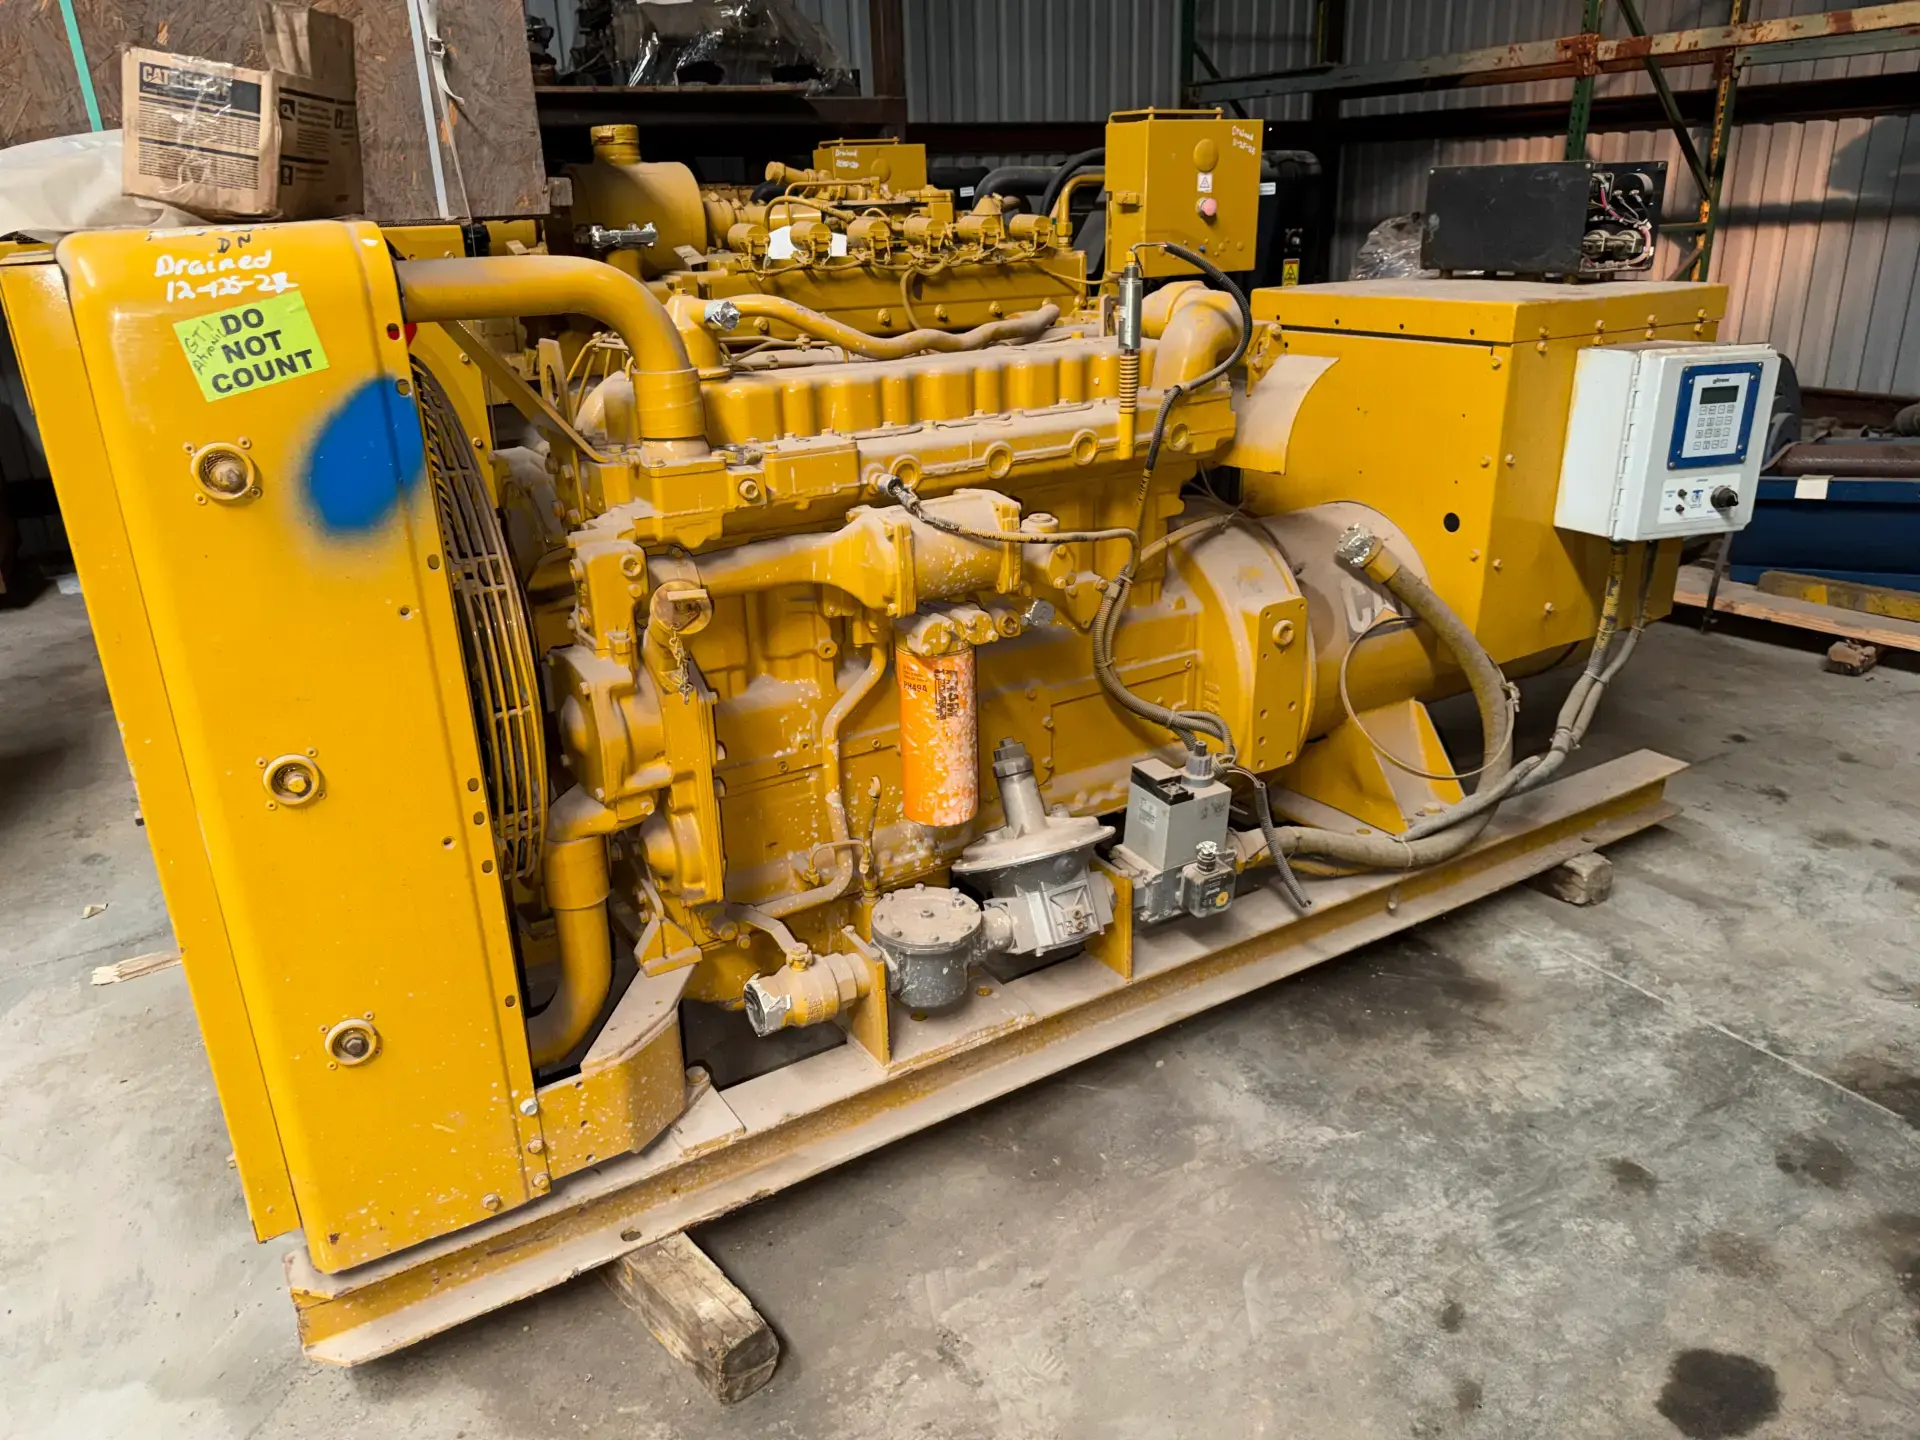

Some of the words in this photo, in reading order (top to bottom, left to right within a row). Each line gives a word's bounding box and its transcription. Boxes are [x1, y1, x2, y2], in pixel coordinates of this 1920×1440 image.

[142, 65, 169, 85] CAT
[154, 249, 272, 277] Drained
[220, 308, 264, 336] DO
[221, 329, 282, 364] NOT
[211, 349, 312, 393] COUNT
[1341, 579, 1412, 634] CA
